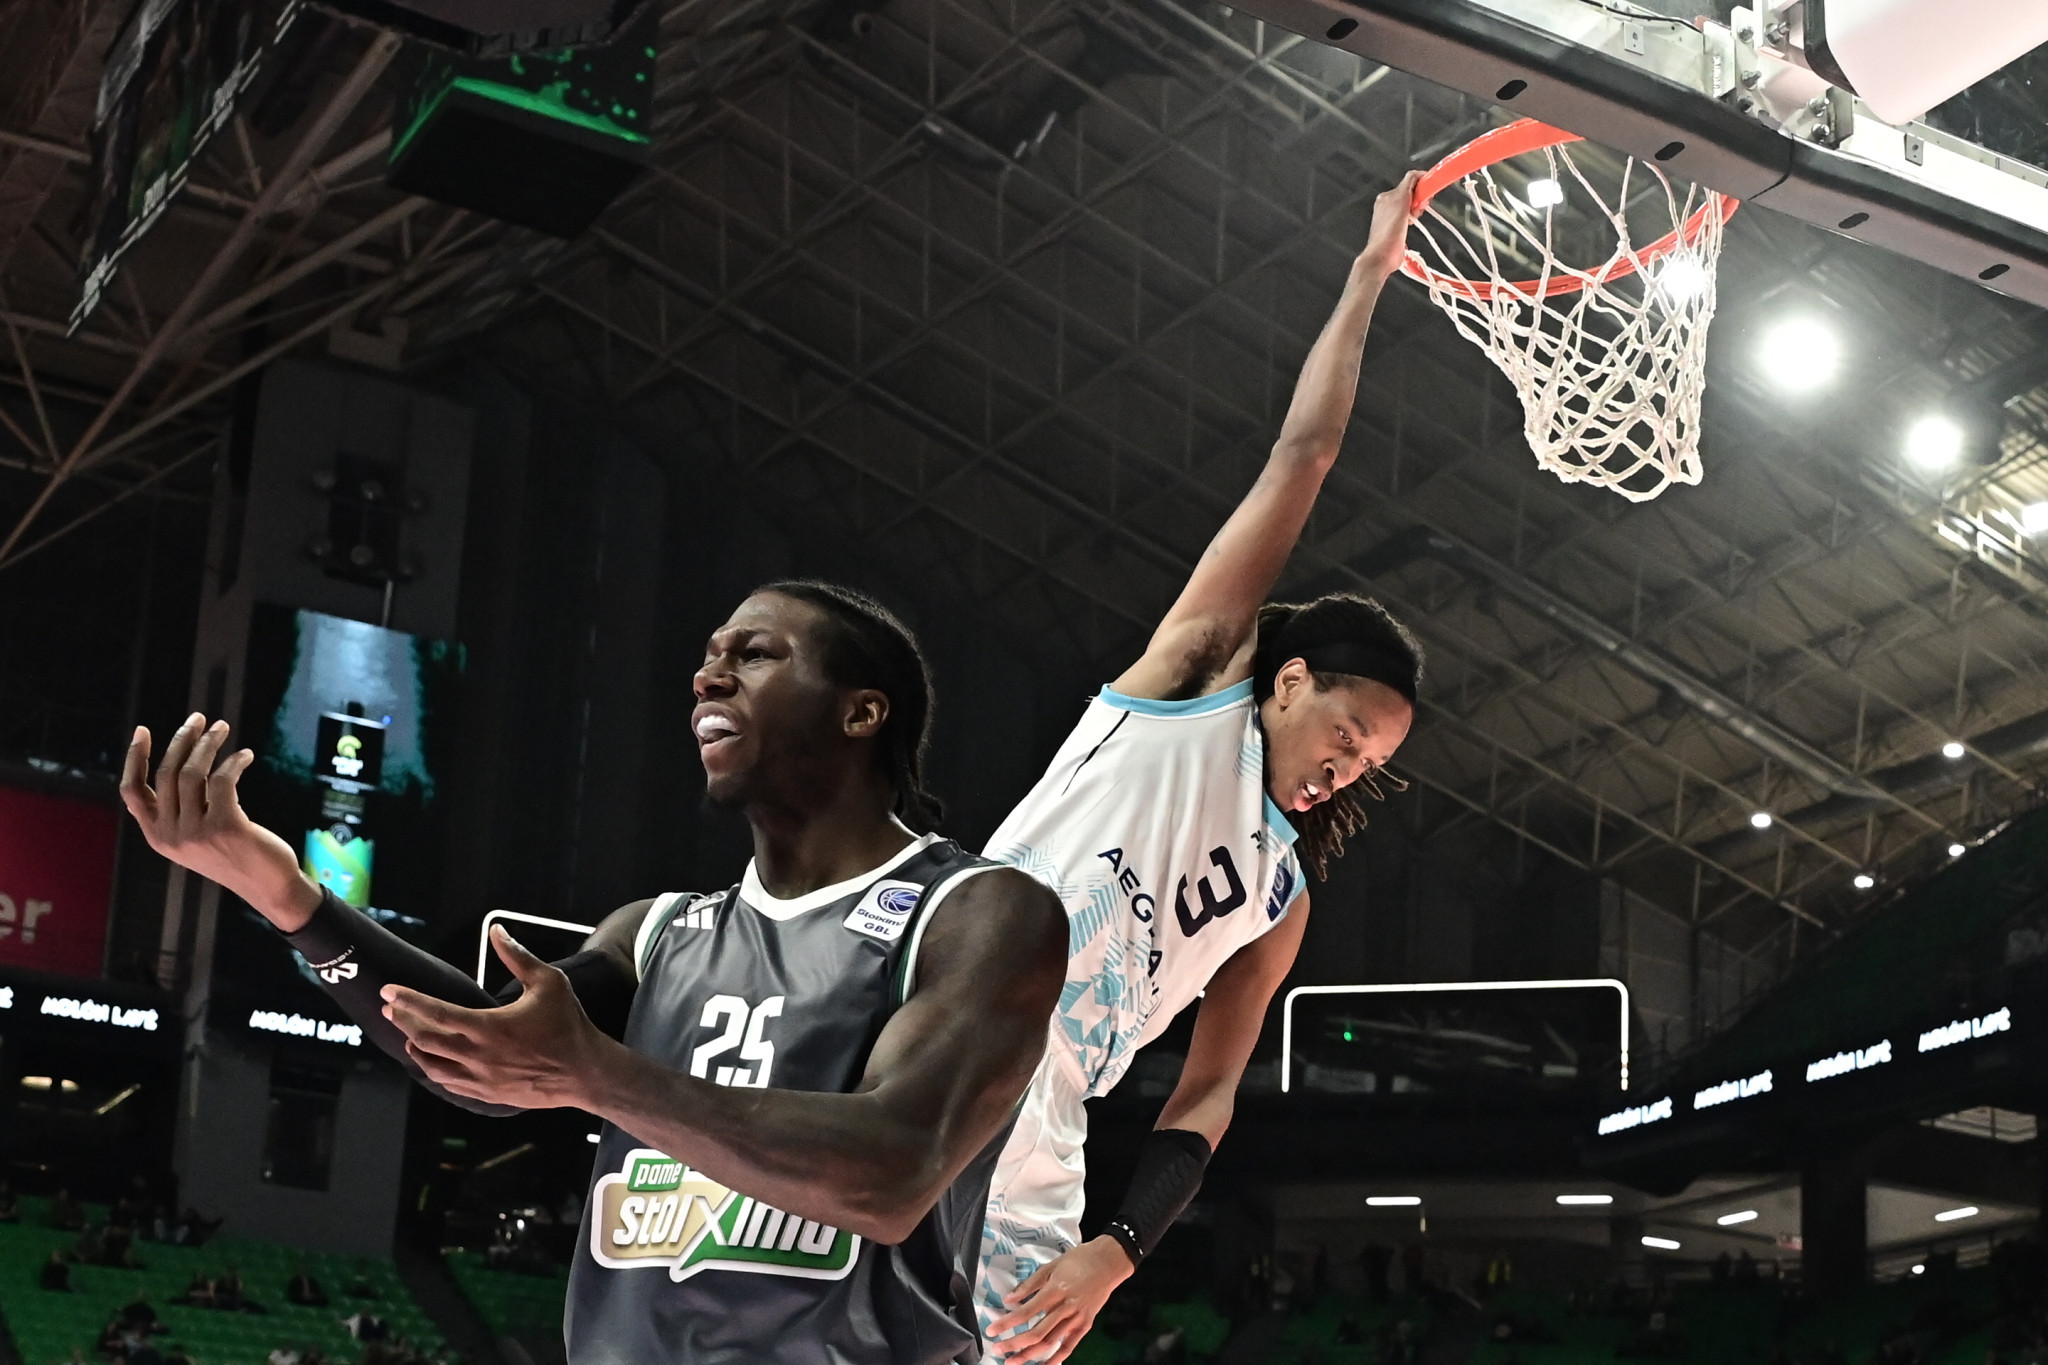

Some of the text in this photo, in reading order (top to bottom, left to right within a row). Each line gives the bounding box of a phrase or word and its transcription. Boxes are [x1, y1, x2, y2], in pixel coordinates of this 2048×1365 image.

[1175, 846, 1247, 938] 3
[864, 922, 891, 936] GBL
[689, 993, 786, 1089] 25
[634, 1162, 682, 1188] pame
